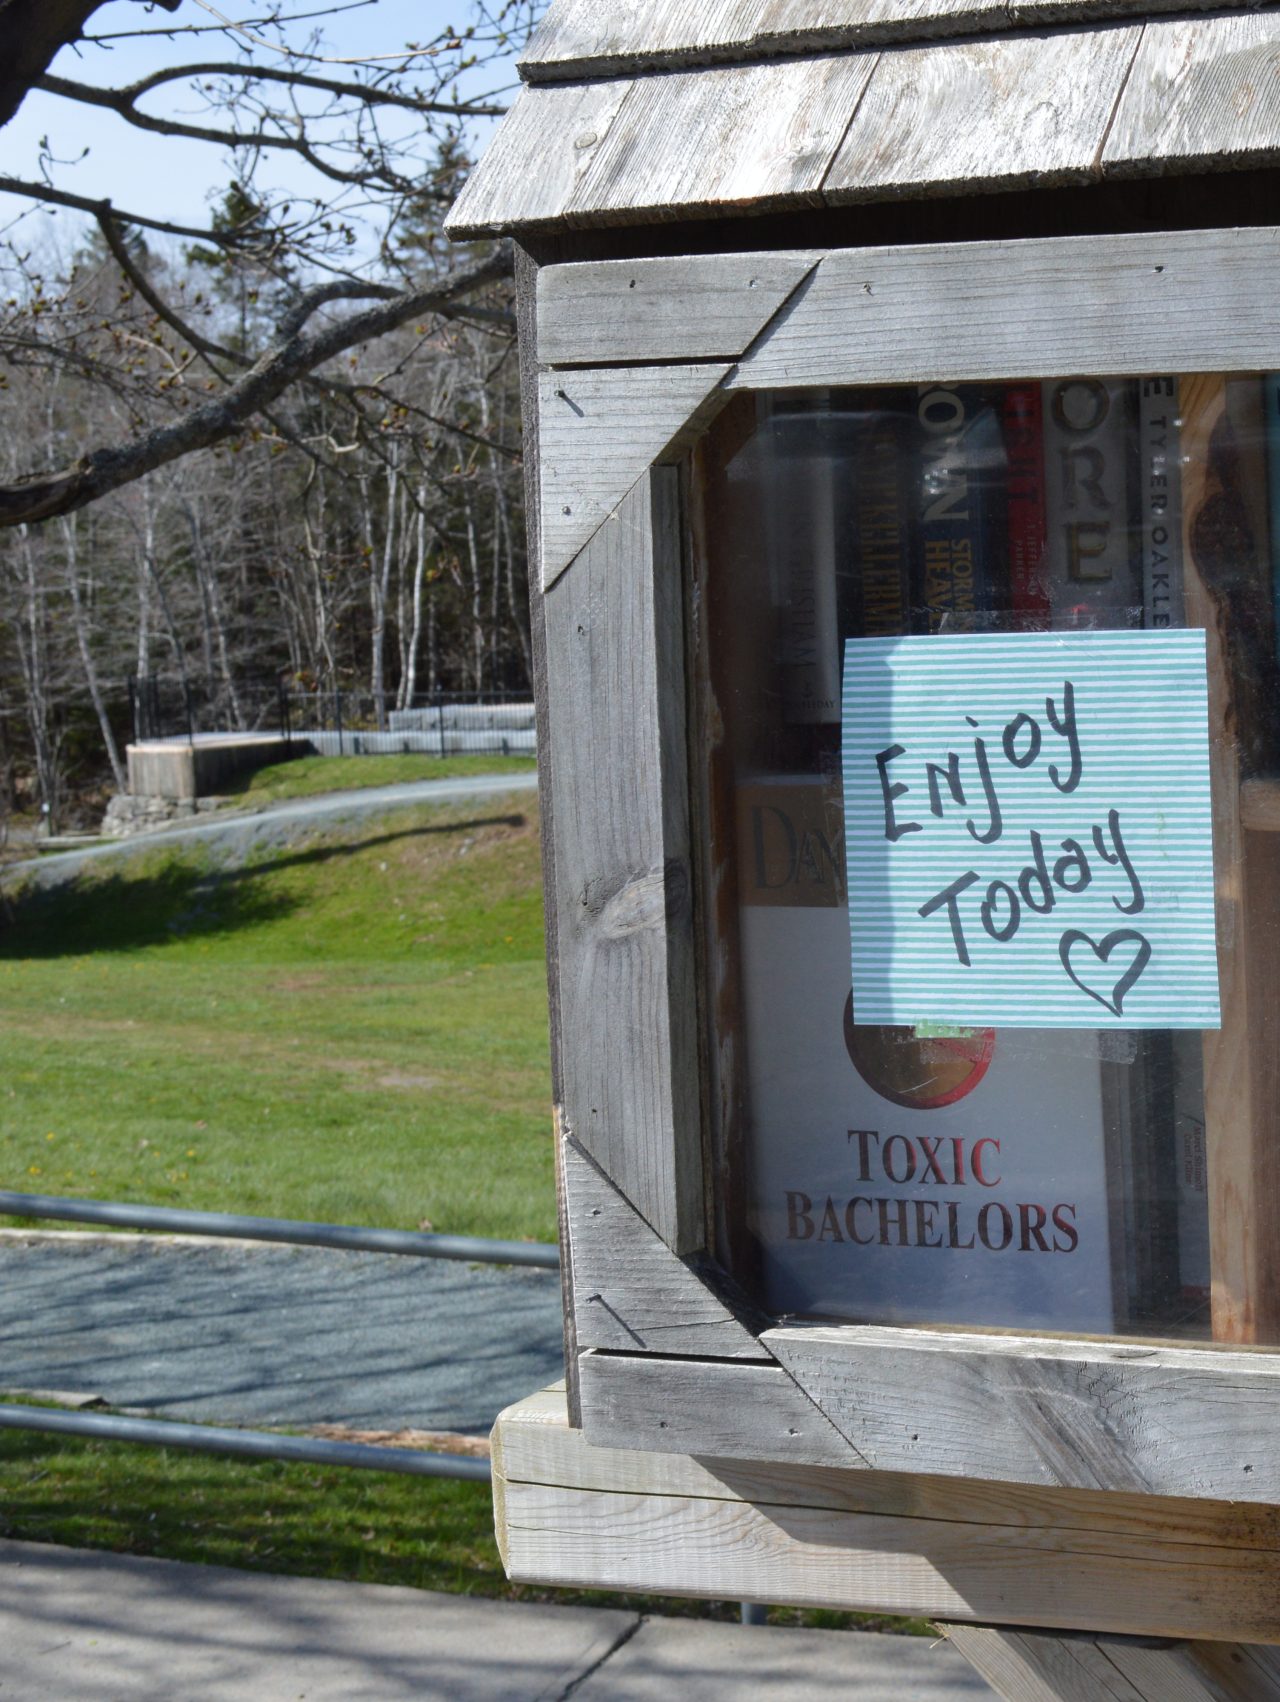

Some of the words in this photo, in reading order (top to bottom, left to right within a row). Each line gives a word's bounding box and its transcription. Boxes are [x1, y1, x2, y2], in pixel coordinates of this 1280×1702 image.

[1149, 415, 1169, 510] TYLER
[860, 503, 903, 636] KELLERMA
[1151, 526, 1171, 628] OAKLE
[875, 680, 1084, 845] Enjoy
[917, 808, 1147, 968] Today
[847, 1129, 1002, 1187] TOXIC
[785, 1190, 1080, 1254] BACHELORS
